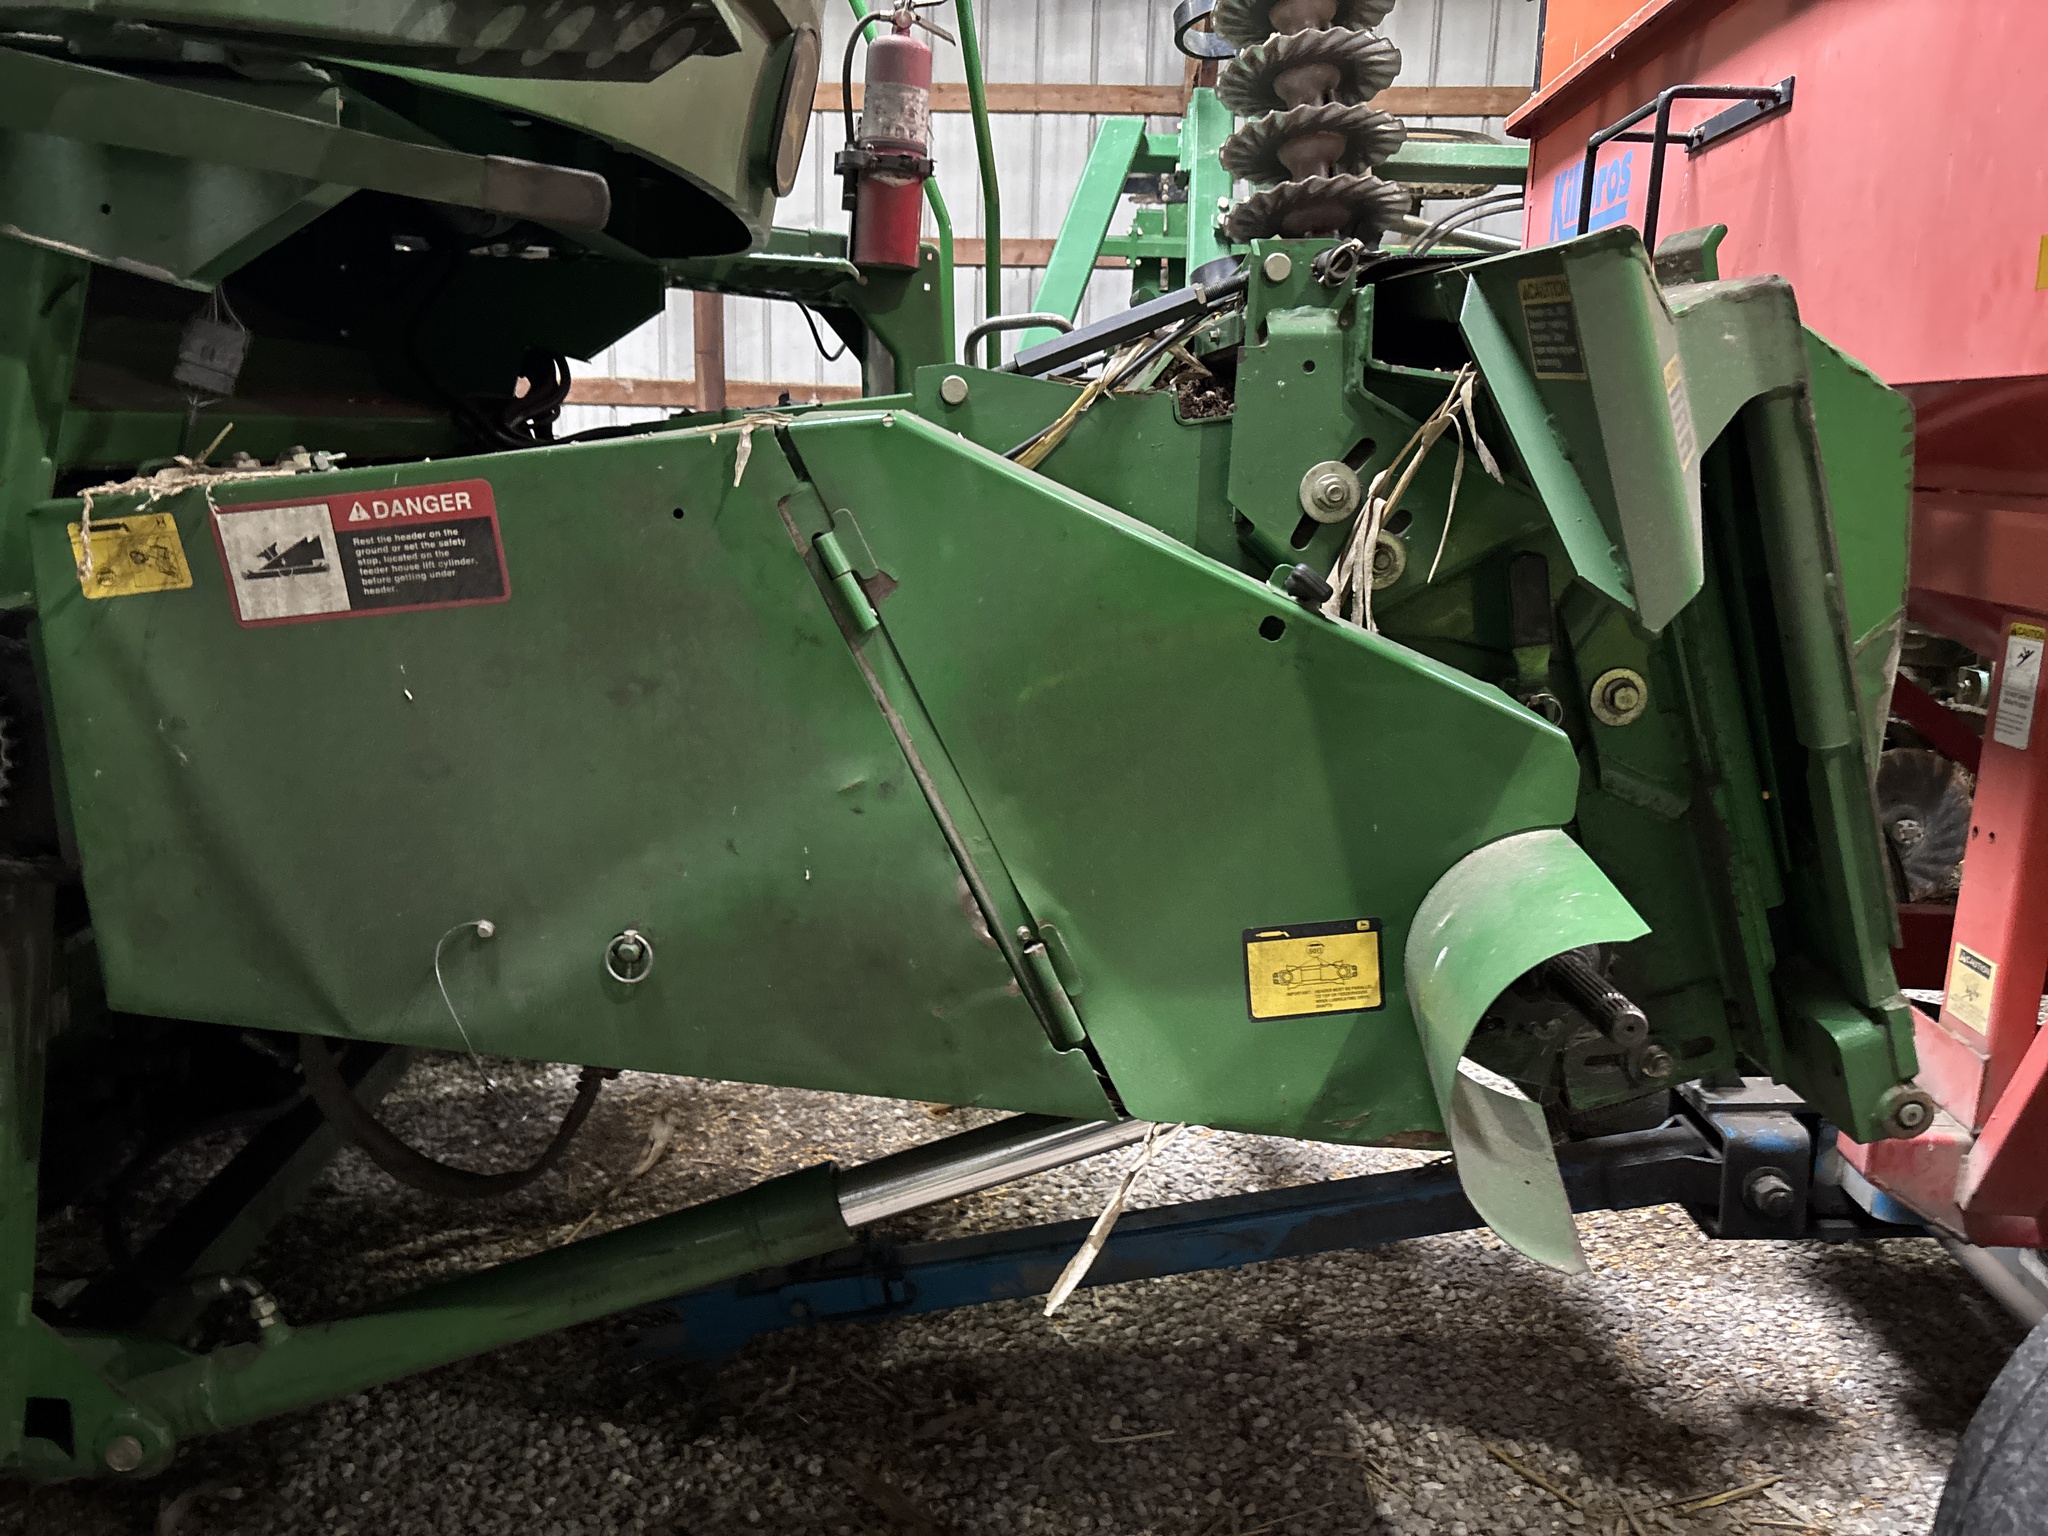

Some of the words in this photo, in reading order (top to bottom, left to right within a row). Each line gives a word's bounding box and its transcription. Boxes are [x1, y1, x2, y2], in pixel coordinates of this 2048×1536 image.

[372, 492, 472, 519] DANGER
[353, 537, 374, 546] Rest
[395, 532, 426, 542] header
[429, 530, 441, 538] on
[443, 528, 458, 536] the
[355, 545, 388, 557] ground
[392, 544, 401, 552] or
[404, 542, 418, 551] set
[421, 541, 435, 549] the
[439, 538, 466, 547] safety
[358, 557, 381, 566] stop,
[384, 553, 417, 562] located
[435, 550, 449, 558] the
[359, 566, 388, 576] feeder
[392, 563, 420, 572] house
[423, 560, 435, 569] lift
[362, 576, 391, 586] before
[395, 573, 427, 584] getting
[430, 570, 455, 578] under
[364, 586, 398, 595] header.
